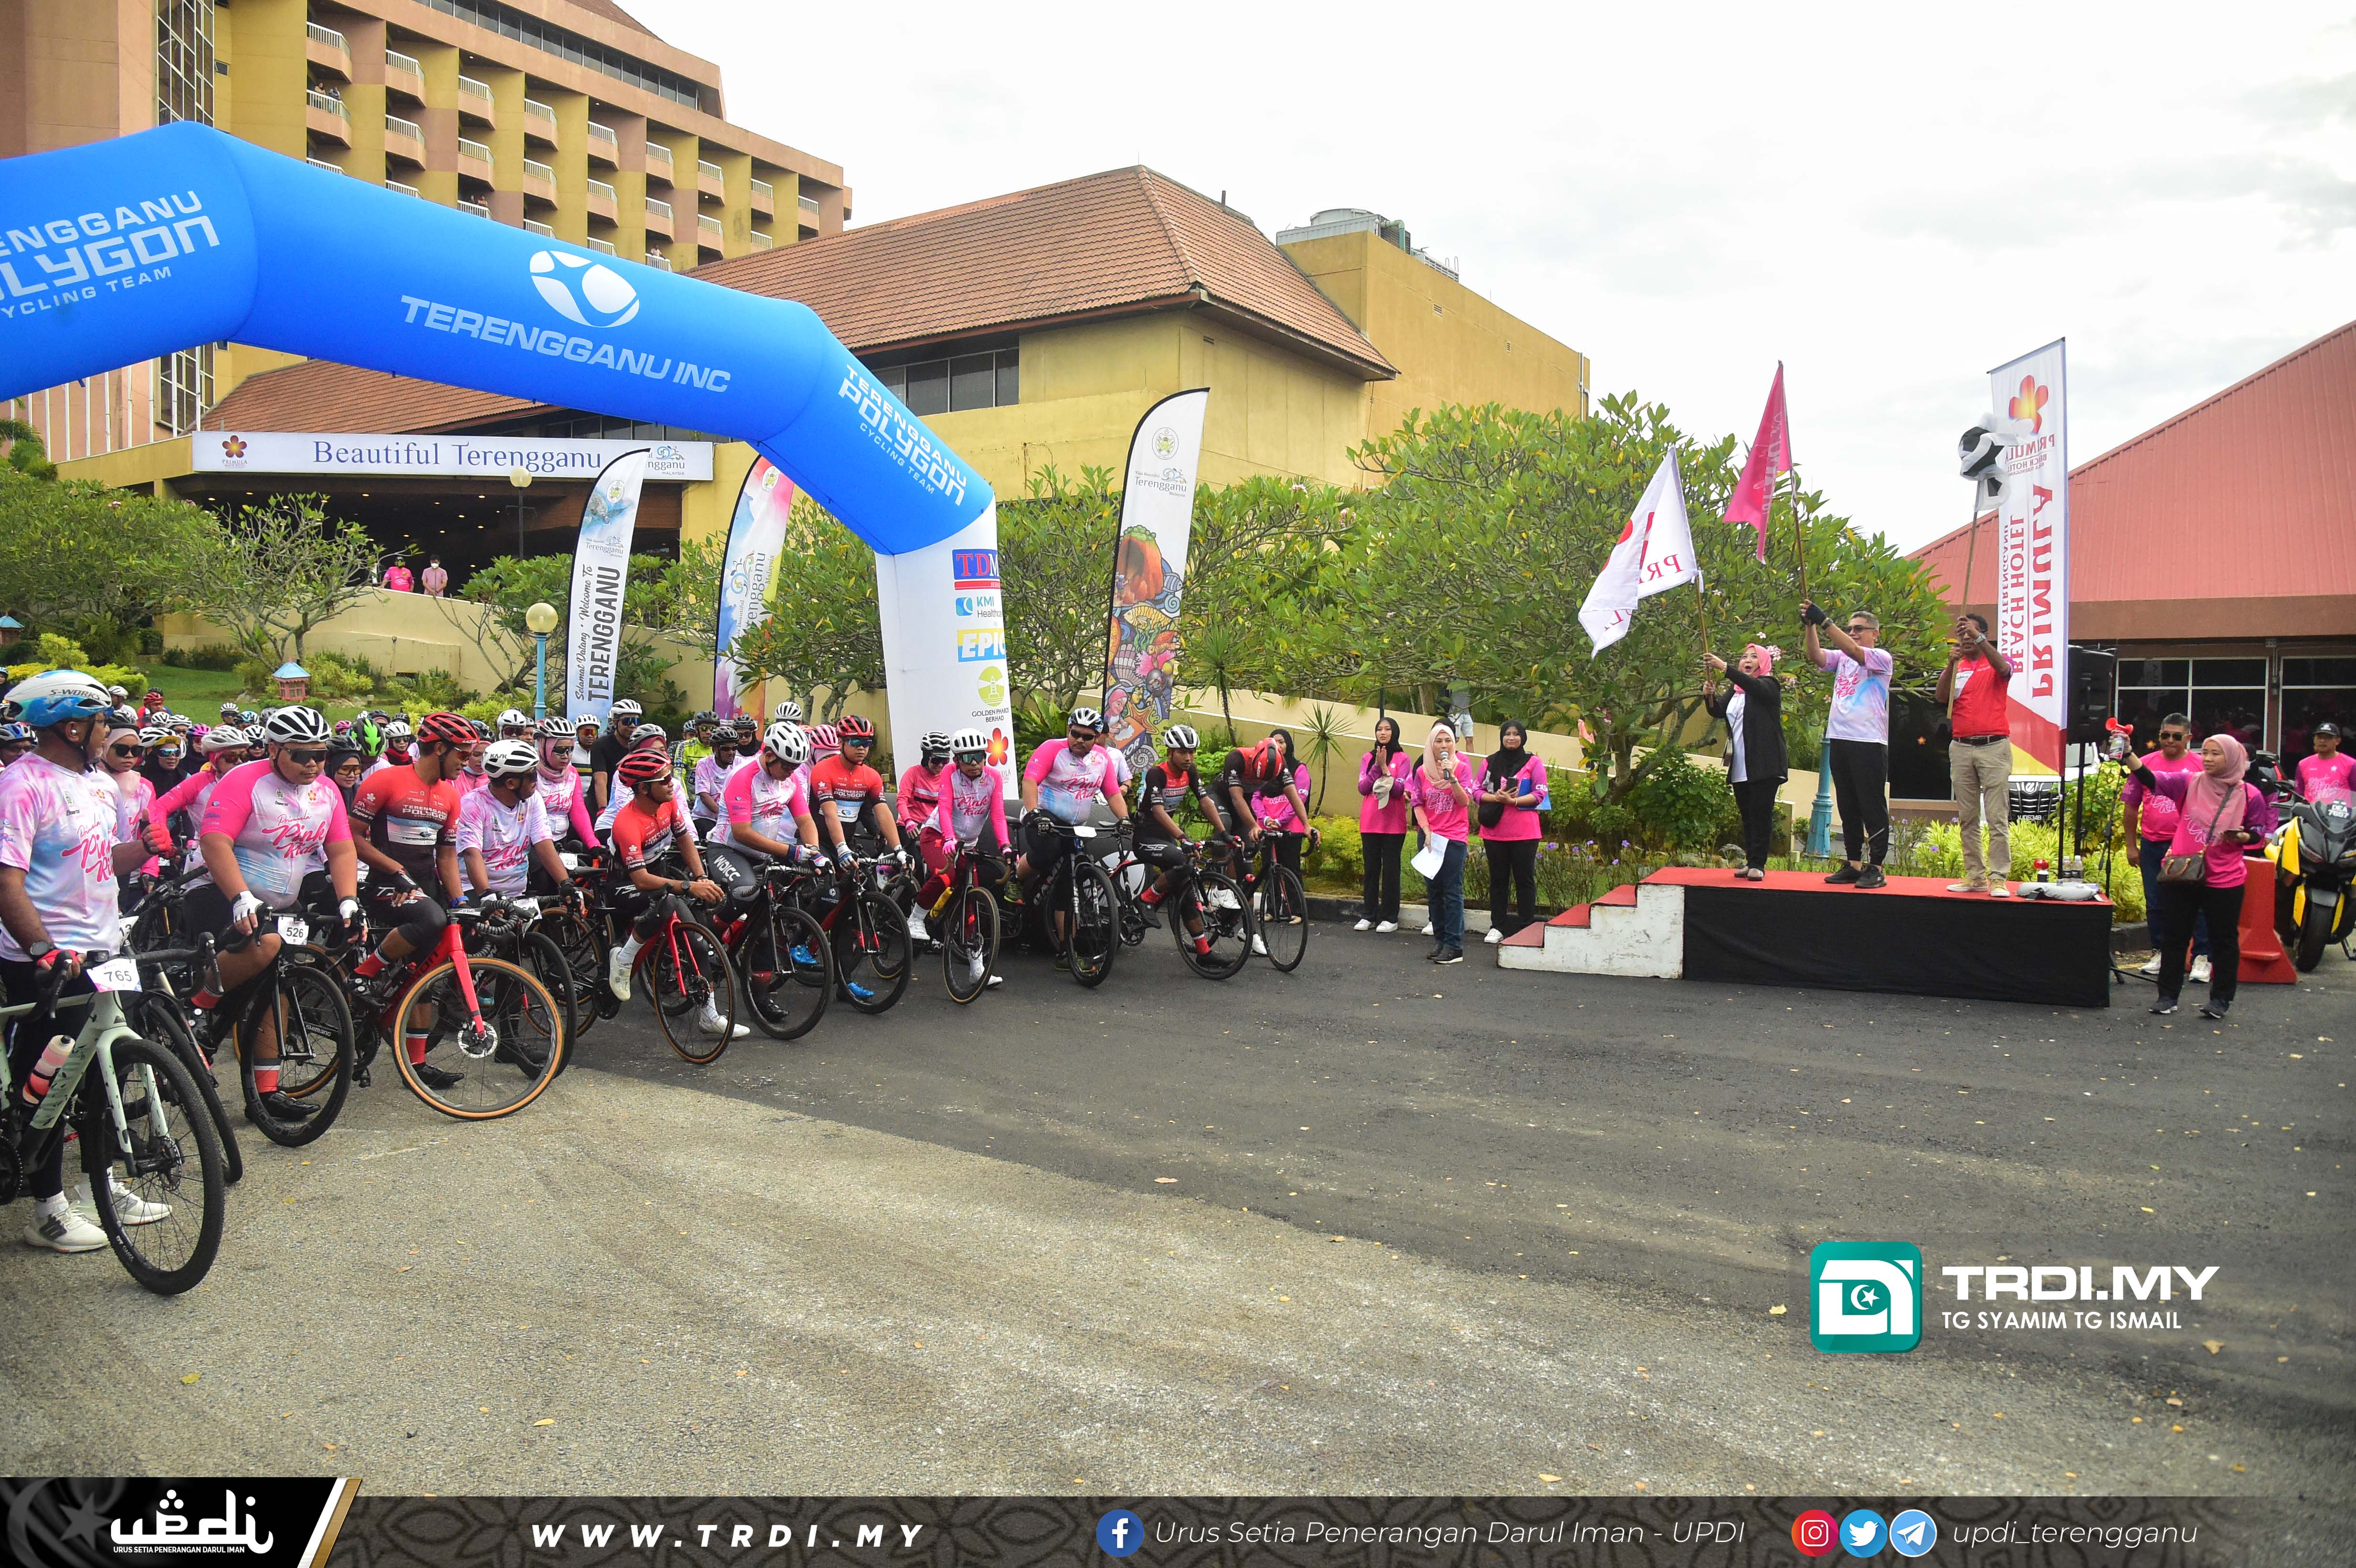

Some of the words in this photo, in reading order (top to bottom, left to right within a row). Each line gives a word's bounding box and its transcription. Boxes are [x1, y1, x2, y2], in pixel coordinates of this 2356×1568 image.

[0, 216, 219, 300] LYGON
[106, 266, 172, 293] TEAM
[401, 295, 671, 379] TERENGGANU
[673, 362, 731, 392] INC
[847, 364, 967, 487] TERENGGANU
[838, 378, 965, 506] POLYGON
[313, 440, 440, 465] Beautiful
[452, 443, 601, 473] Terengganu
[645, 461, 685, 471] ngganu
[860, 423, 905, 467] CYCLING
[908, 467, 935, 494] TEAM
[1135, 476, 1186, 492] Terengganu
[586, 542, 623, 554] Terengganu
[582, 564, 593, 577] To
[957, 554, 999, 577] TDM
[578, 579, 591, 621] Welcome
[977, 597, 994, 607] KMI
[588, 566, 621, 702] TERENGGANU
[577, 632, 590, 664] Datang
[49, 689, 100, 700] S-WORKS
[575, 664, 585, 701] Selamat
[262, 821, 326, 846] Pink
[286, 927, 304, 938] 526
[104, 970, 132, 982] 765
[306, 1024, 331, 1036] SHIMANO
